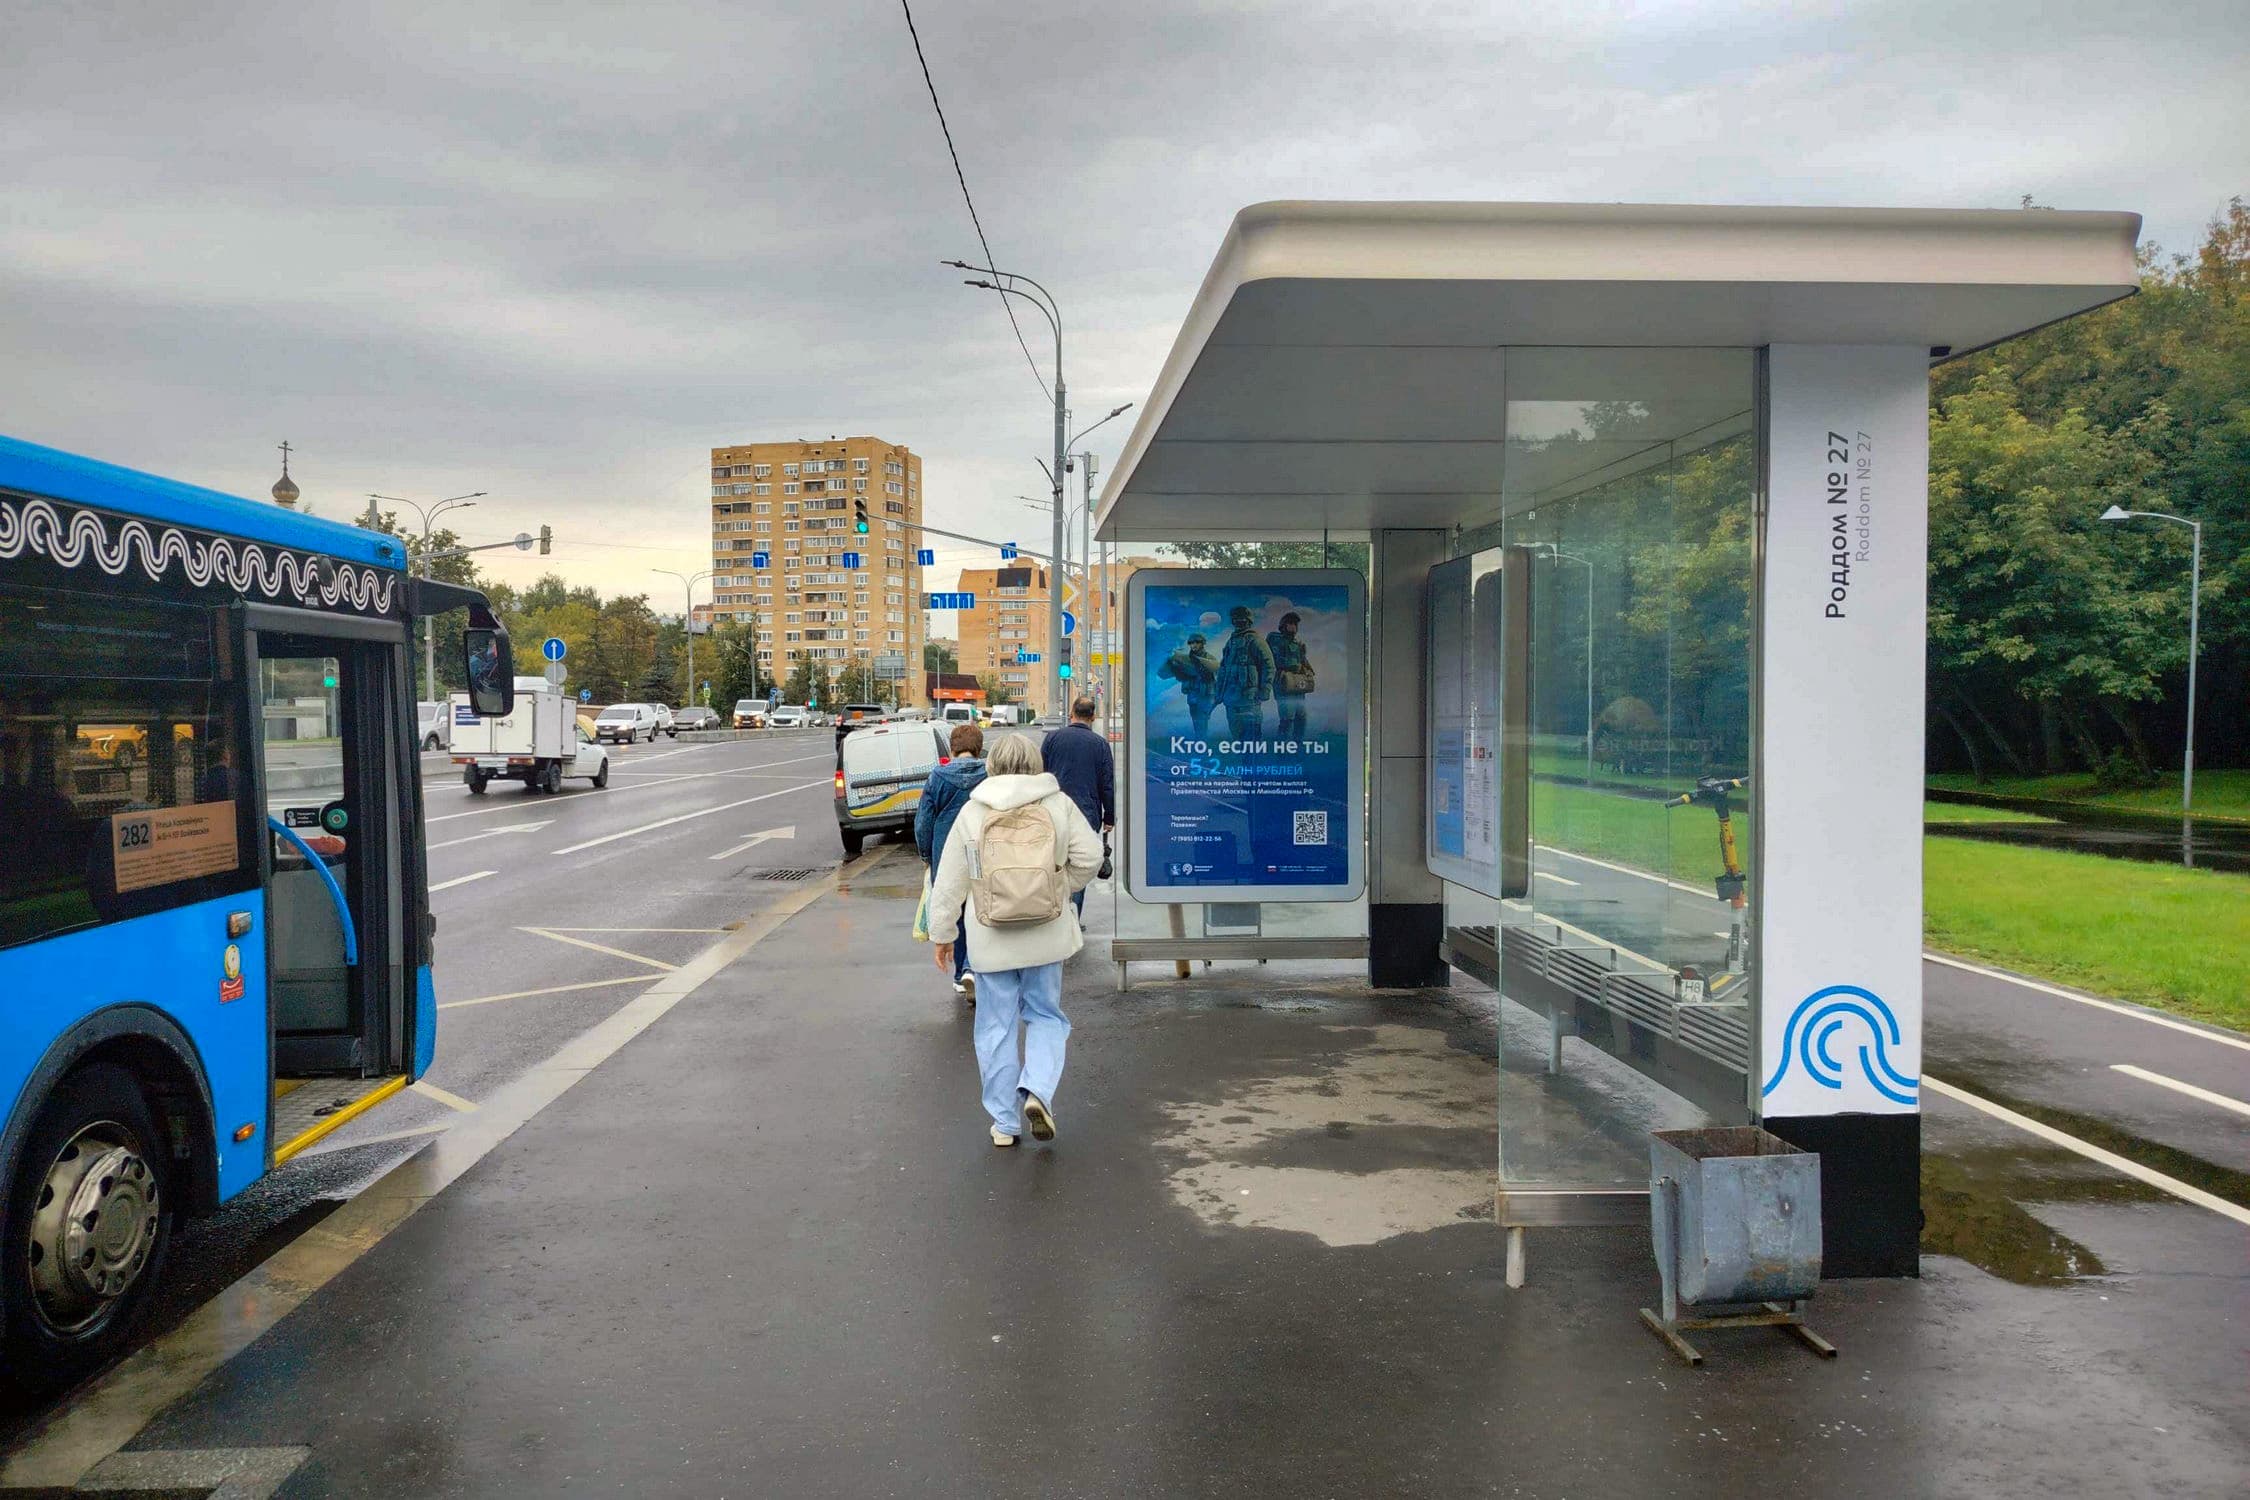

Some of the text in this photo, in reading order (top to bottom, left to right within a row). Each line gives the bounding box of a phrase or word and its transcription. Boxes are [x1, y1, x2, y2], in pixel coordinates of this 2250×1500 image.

[1855, 431, 1872, 562] Roddom № 27
[1826, 431, 1850, 618] Роддом № 27
[1171, 736, 1329, 756] Кто, если не ты
[1190, 758, 1221, 778] 5,2
[1223, 765, 1253, 776] МЛН
[1256, 763, 1303, 776] РУБЛЕЙ
[120, 822, 150, 847] 282
